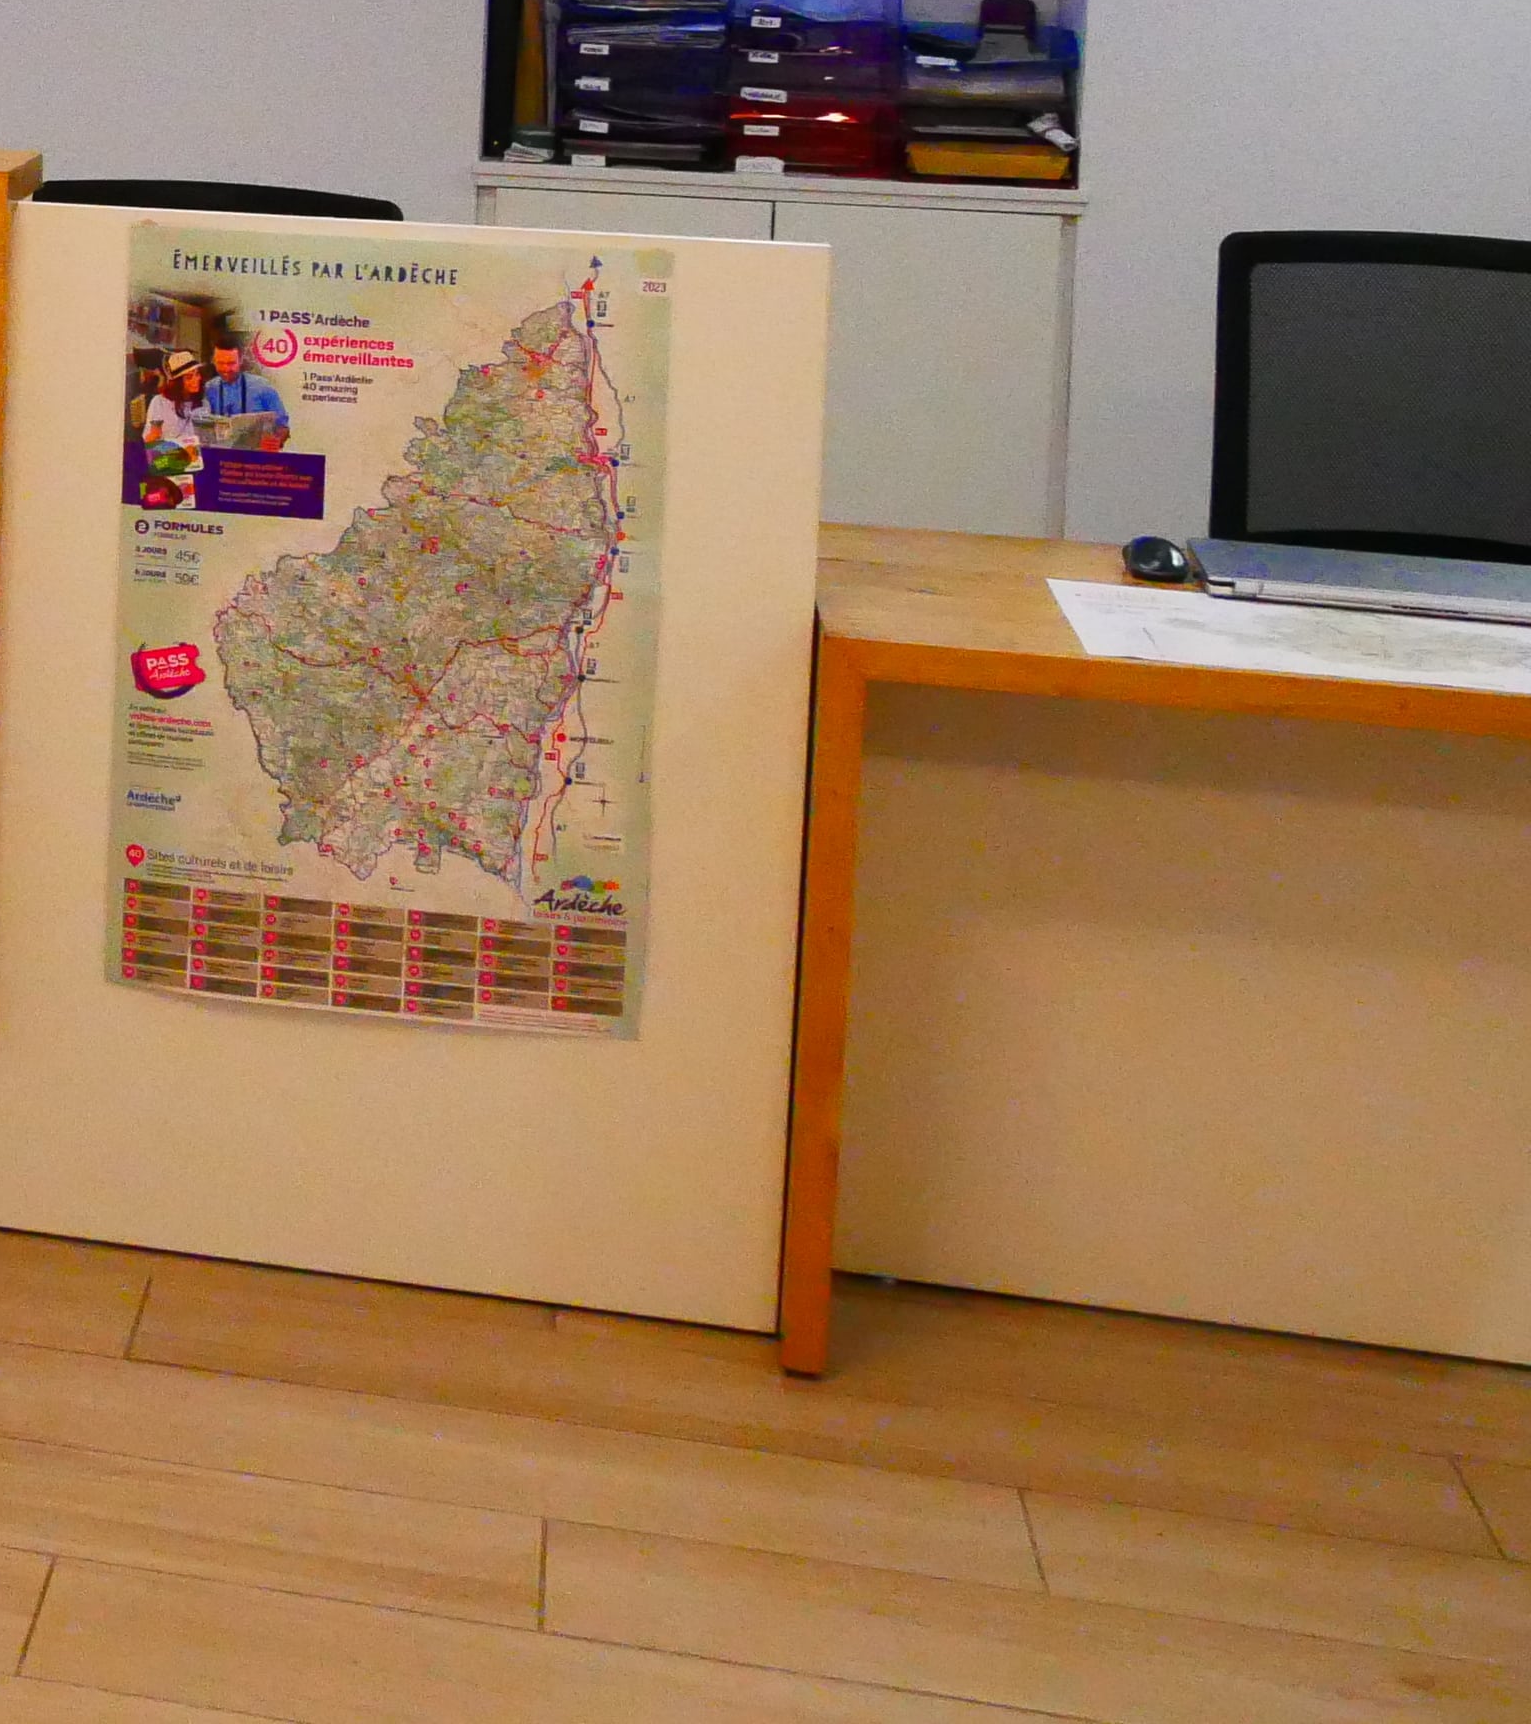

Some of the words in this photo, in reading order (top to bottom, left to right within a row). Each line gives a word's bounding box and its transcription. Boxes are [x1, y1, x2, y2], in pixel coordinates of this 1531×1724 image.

[173, 249, 301, 276] ÉMERVEILLÉS
[311, 261, 344, 278] PAR
[642, 281, 667, 293] 2023
[262, 337, 288, 355] 40
[303, 335, 395, 353] expériences
[302, 352, 414, 369] émerveillantes
[154, 520, 224, 536] FORMULES
[175, 549, 201, 565] 45€
[146, 653, 189, 670] PASS
[147, 849, 176, 862] Sites
[178, 855, 227, 869] culturels
[243, 859, 258, 871] de
[533, 889, 625, 916] Ardèche
